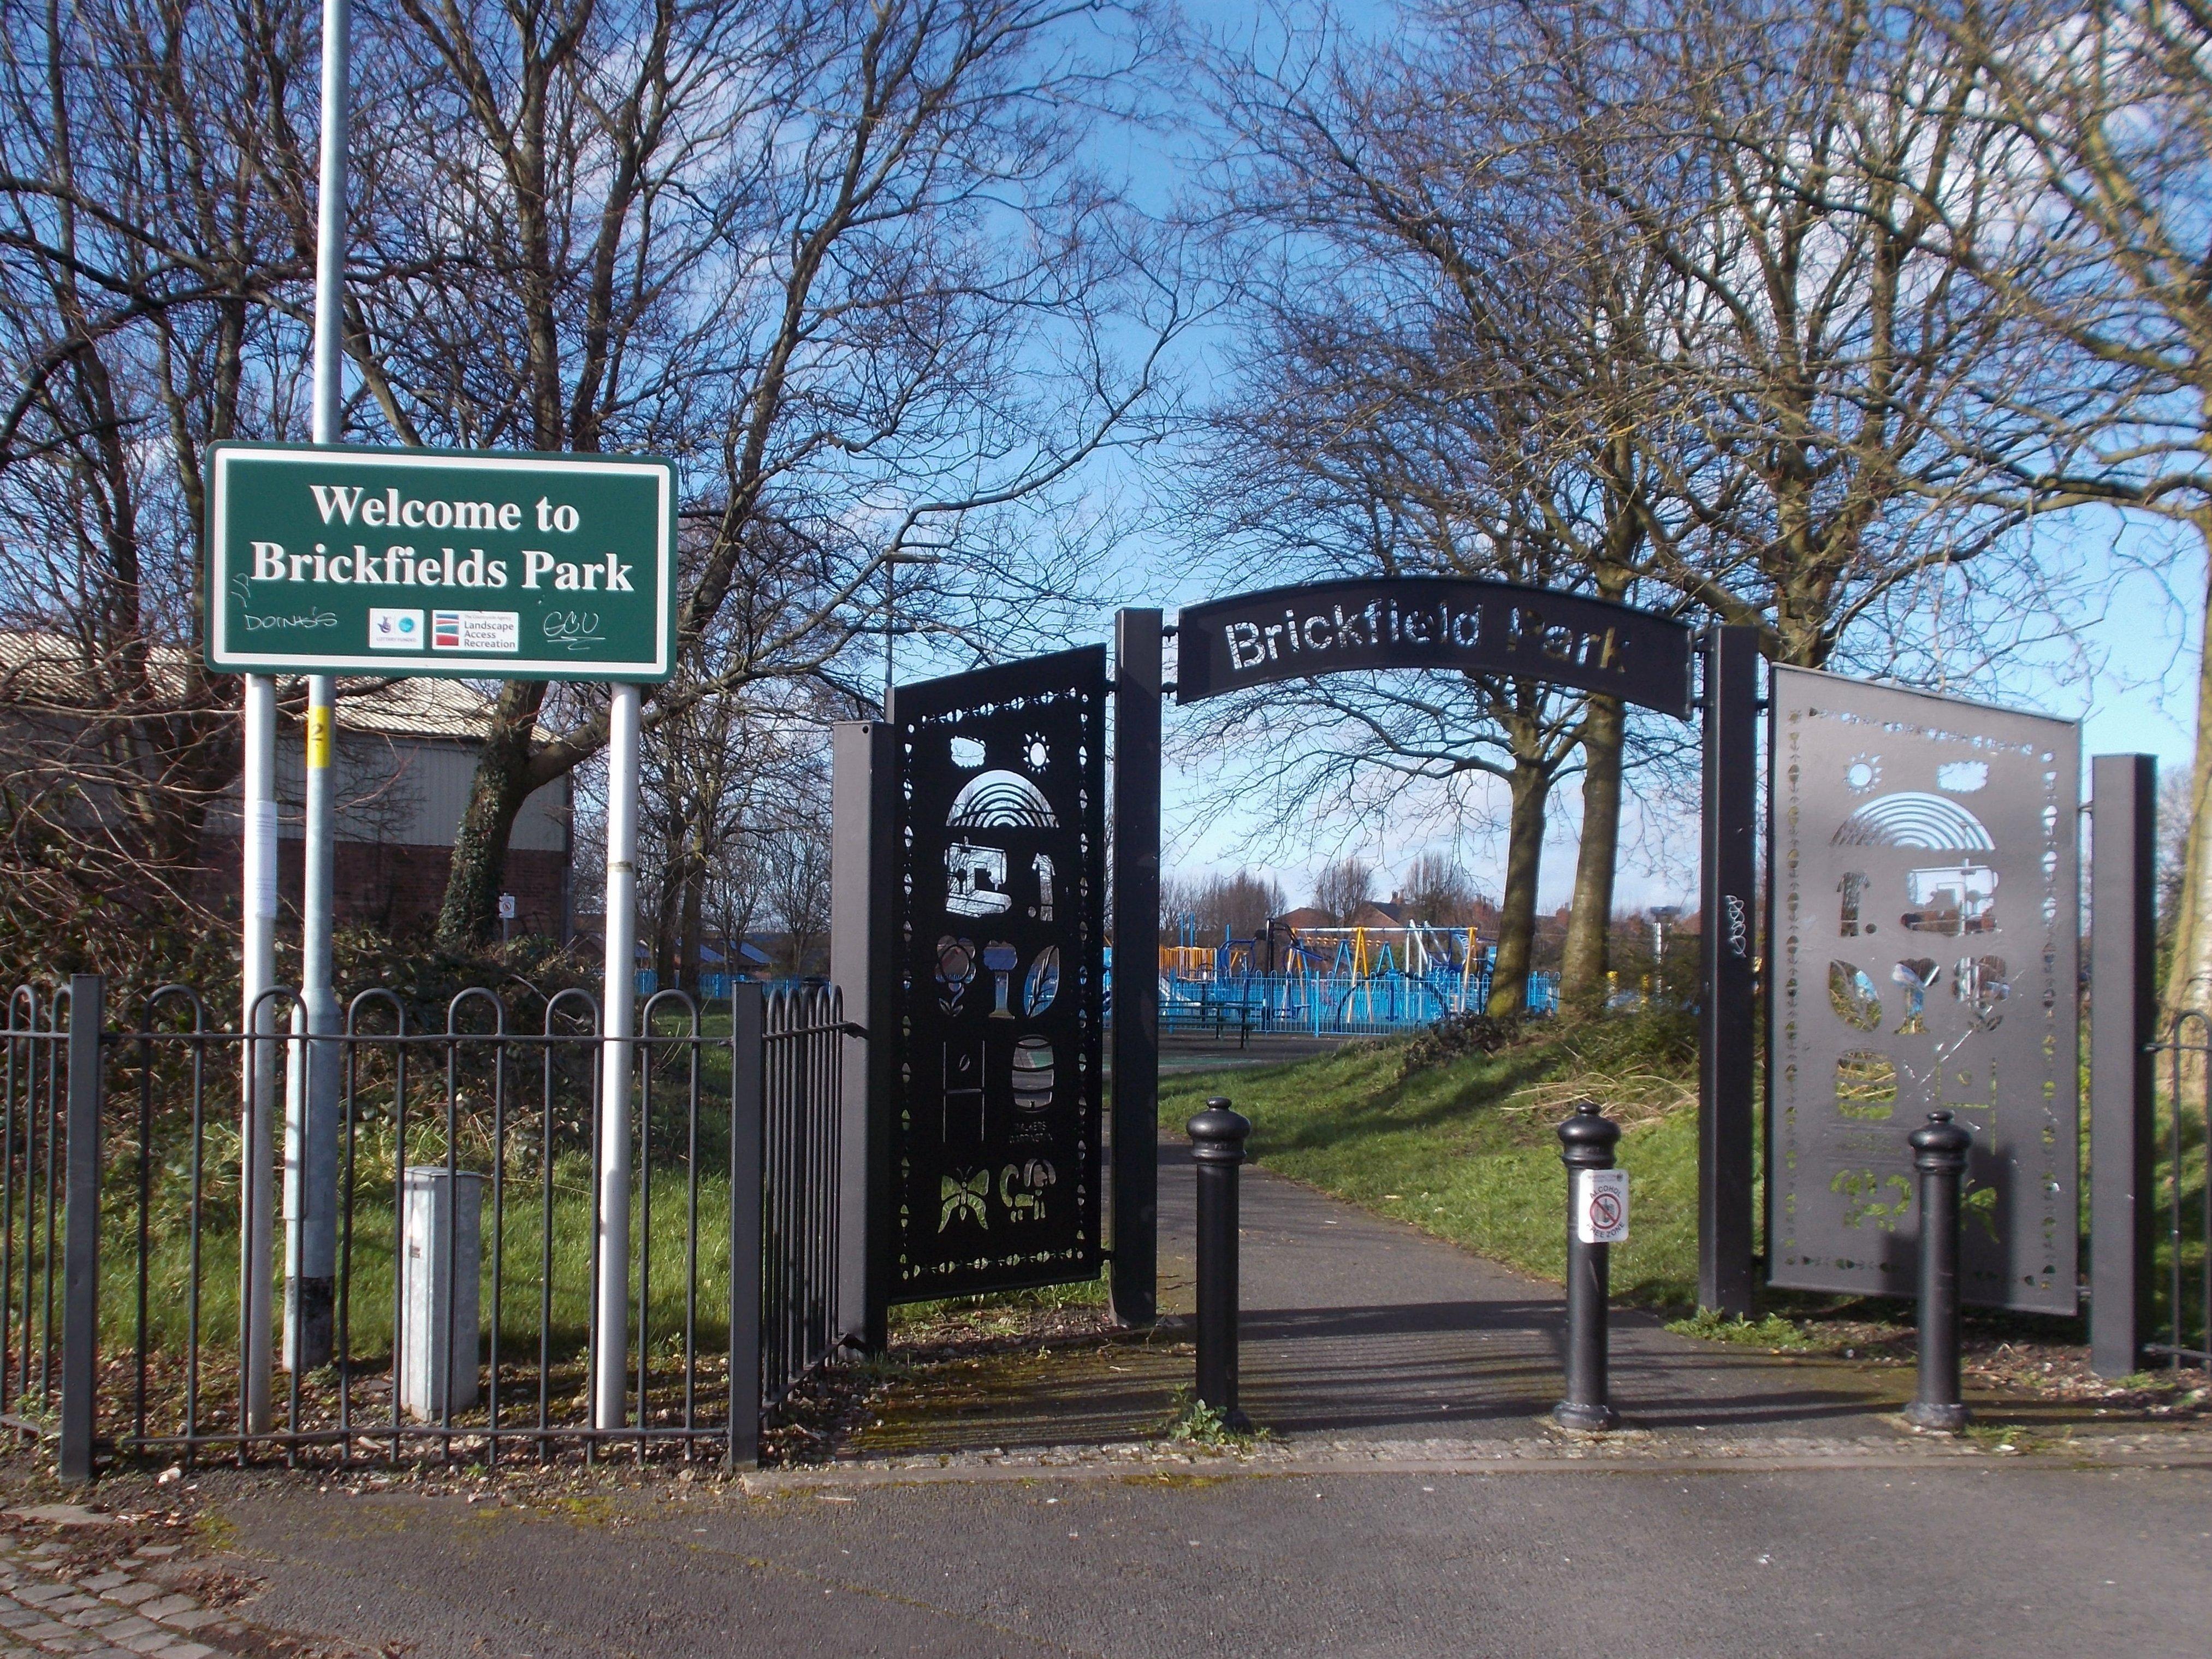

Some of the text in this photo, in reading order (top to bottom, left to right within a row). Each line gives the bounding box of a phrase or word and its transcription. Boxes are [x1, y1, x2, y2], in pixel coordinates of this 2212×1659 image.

[309, 484, 580, 533] Welcome to
[250, 541, 634, 591] Brickfields Park
[464, 620, 514, 632] Landscape
[465, 630, 496, 638] Access
[464, 638, 515, 648] Recreation
[1225, 599, 1630, 673] Brickfield Park
[311, 722, 324, 742] 2
[1590, 1185, 1621, 1199] ALCOHOL
[1606, 1221, 1625, 1238] ZONE
